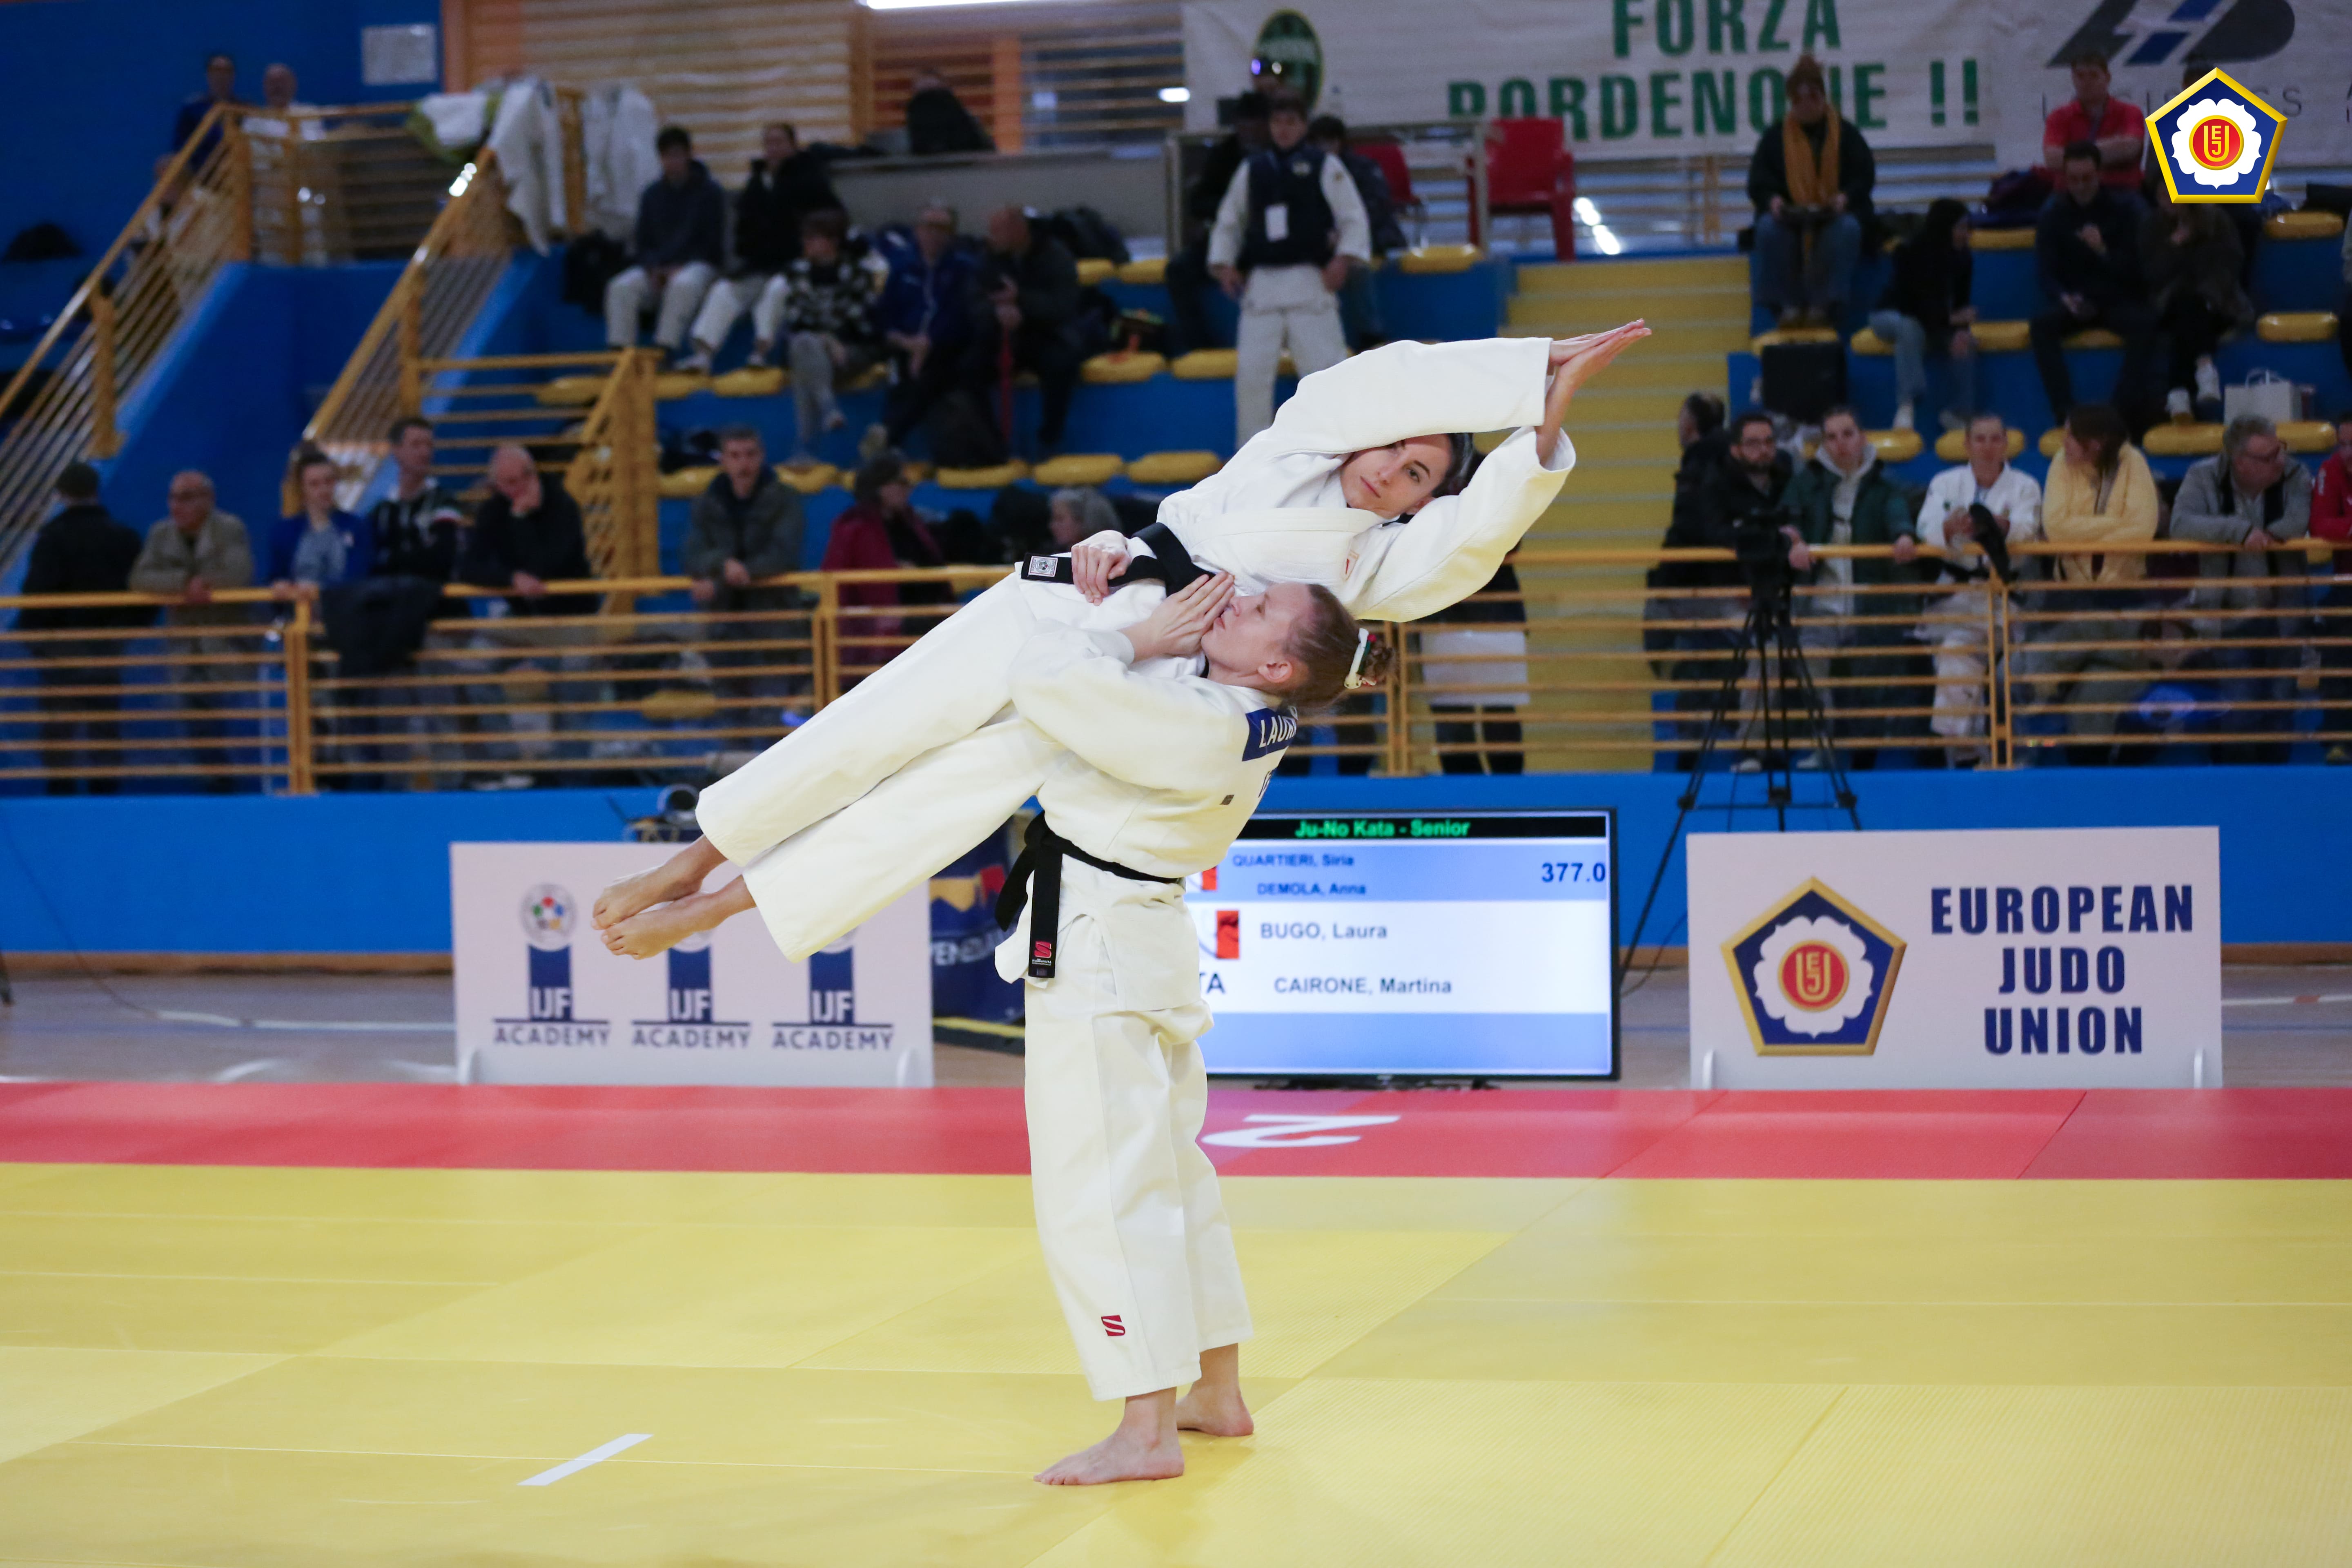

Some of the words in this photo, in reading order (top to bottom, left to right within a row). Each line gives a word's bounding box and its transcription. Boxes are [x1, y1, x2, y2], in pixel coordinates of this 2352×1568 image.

[1613, 0, 1841, 58] FORZA
[1448, 63, 1886, 140] PORDENOE
[1931, 58, 1979, 127] !!
[1295, 819, 1349, 837] Ju-No
[1353, 820, 1395, 837] Kata
[1410, 818, 1470, 837] Senior
[1322, 853, 1354, 866] Siria
[1541, 862, 1606, 883] 377.0
[1329, 882, 1366, 895] Anna
[1931, 885, 2192, 935] EUROPEAN
[1260, 922, 1326, 941] BUGO,
[1332, 922, 1388, 939] Laura
[1998, 945, 2125, 995] JUDO
[1199, 971, 1226, 994] TA
[1273, 977, 1373, 996] CAIRONE,
[1379, 976, 1452, 994] Martina
[532, 987, 571, 1018] IJF
[670, 988, 711, 1020] IJF
[811, 990, 853, 1022] IJF
[494, 1026, 610, 1046] ACADEMY
[631, 1028, 751, 1048] ACADEMY
[772, 1030, 894, 1050] ACADEMY
[1984, 1006, 2143, 1055] UNION
